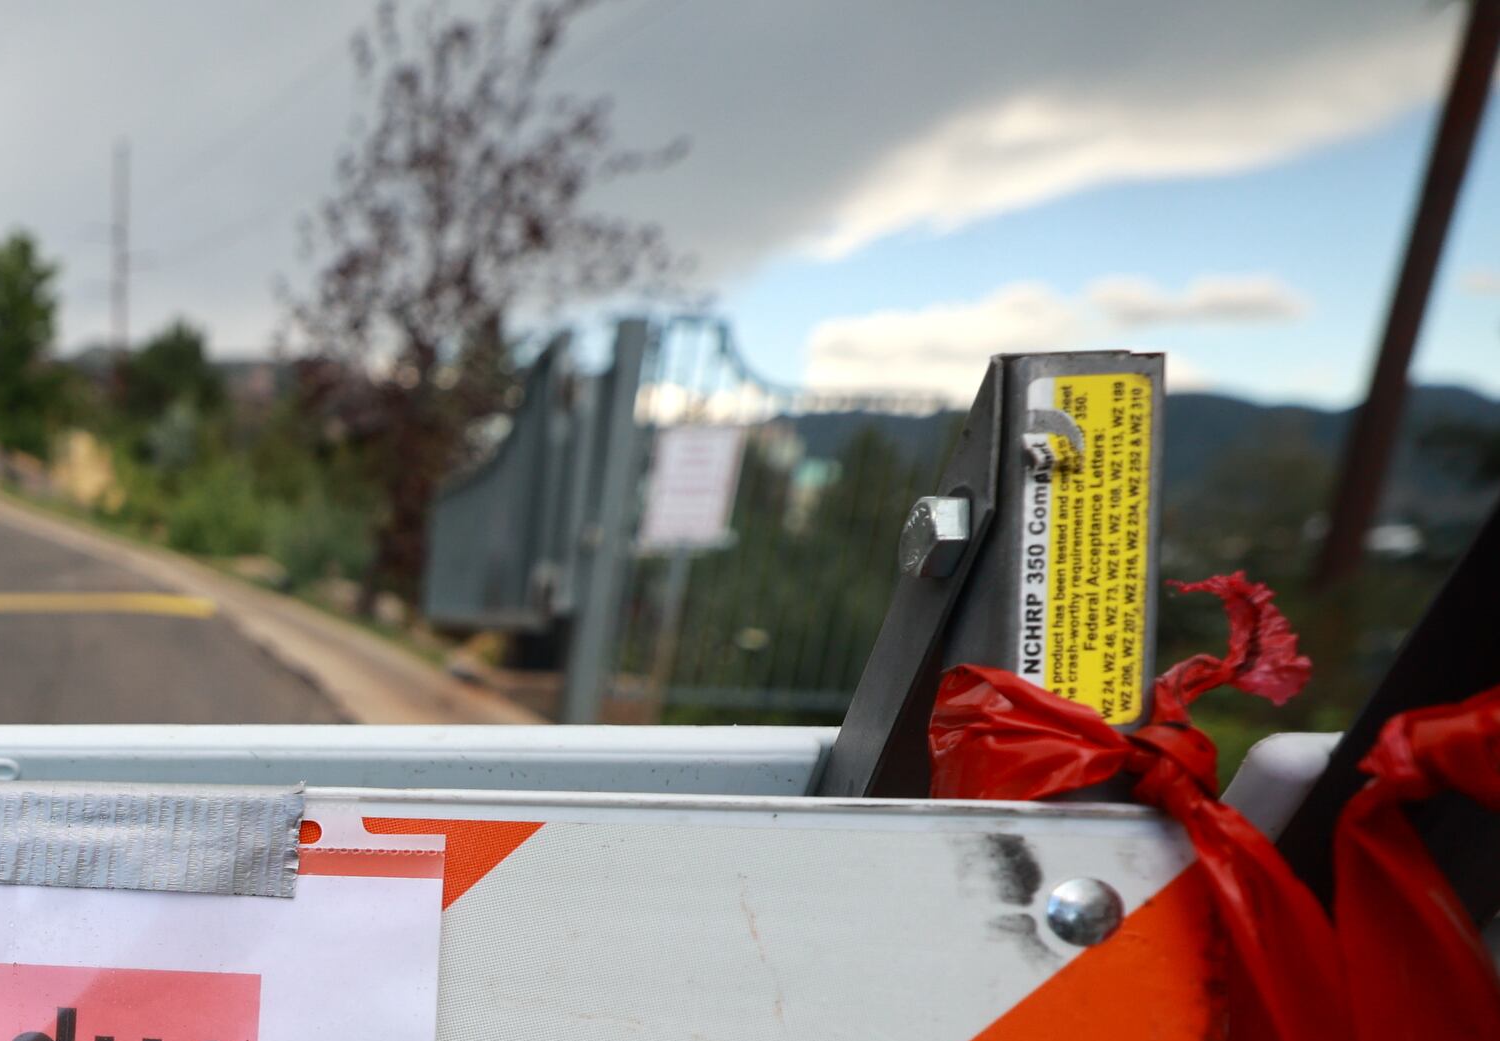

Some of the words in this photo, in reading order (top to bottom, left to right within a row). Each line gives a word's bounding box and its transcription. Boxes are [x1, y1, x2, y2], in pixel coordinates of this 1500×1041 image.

[1112, 407, 1124, 428] WZ
[1130, 414, 1142, 434] WZ
[1090, 428, 1106, 488] Letters:
[1110, 460, 1122, 481] WZ
[1073, 479, 1084, 492] of
[1128, 477, 1140, 497] WZ
[1057, 496, 1069, 519] and
[1109, 514, 1121, 534] WZ
[1056, 524, 1068, 564] tested
[1070, 498, 1084, 587] requirements
[1086, 494, 1104, 586] Acceptance
[1126, 530, 1138, 551] WZ
[1026, 544, 1045, 584] 350
[1106, 560, 1120, 580] WZ
[1053, 569, 1066, 600] been
[1124, 584, 1137, 604] WZ
[1052, 605, 1065, 628] has
[1083, 592, 1100, 651] Federal
[1105, 606, 1118, 626] WZ
[1024, 594, 1043, 674] NCHRP
[1067, 593, 1083, 682] crash-worthy
[1051, 632, 1065, 683] product
[1122, 638, 1134, 658] WZ
[1103, 652, 1116, 673] WZ
[1103, 677, 1116, 694] 24,
[1102, 699, 1113, 719] WZ
[1120, 691, 1132, 712] WZ
